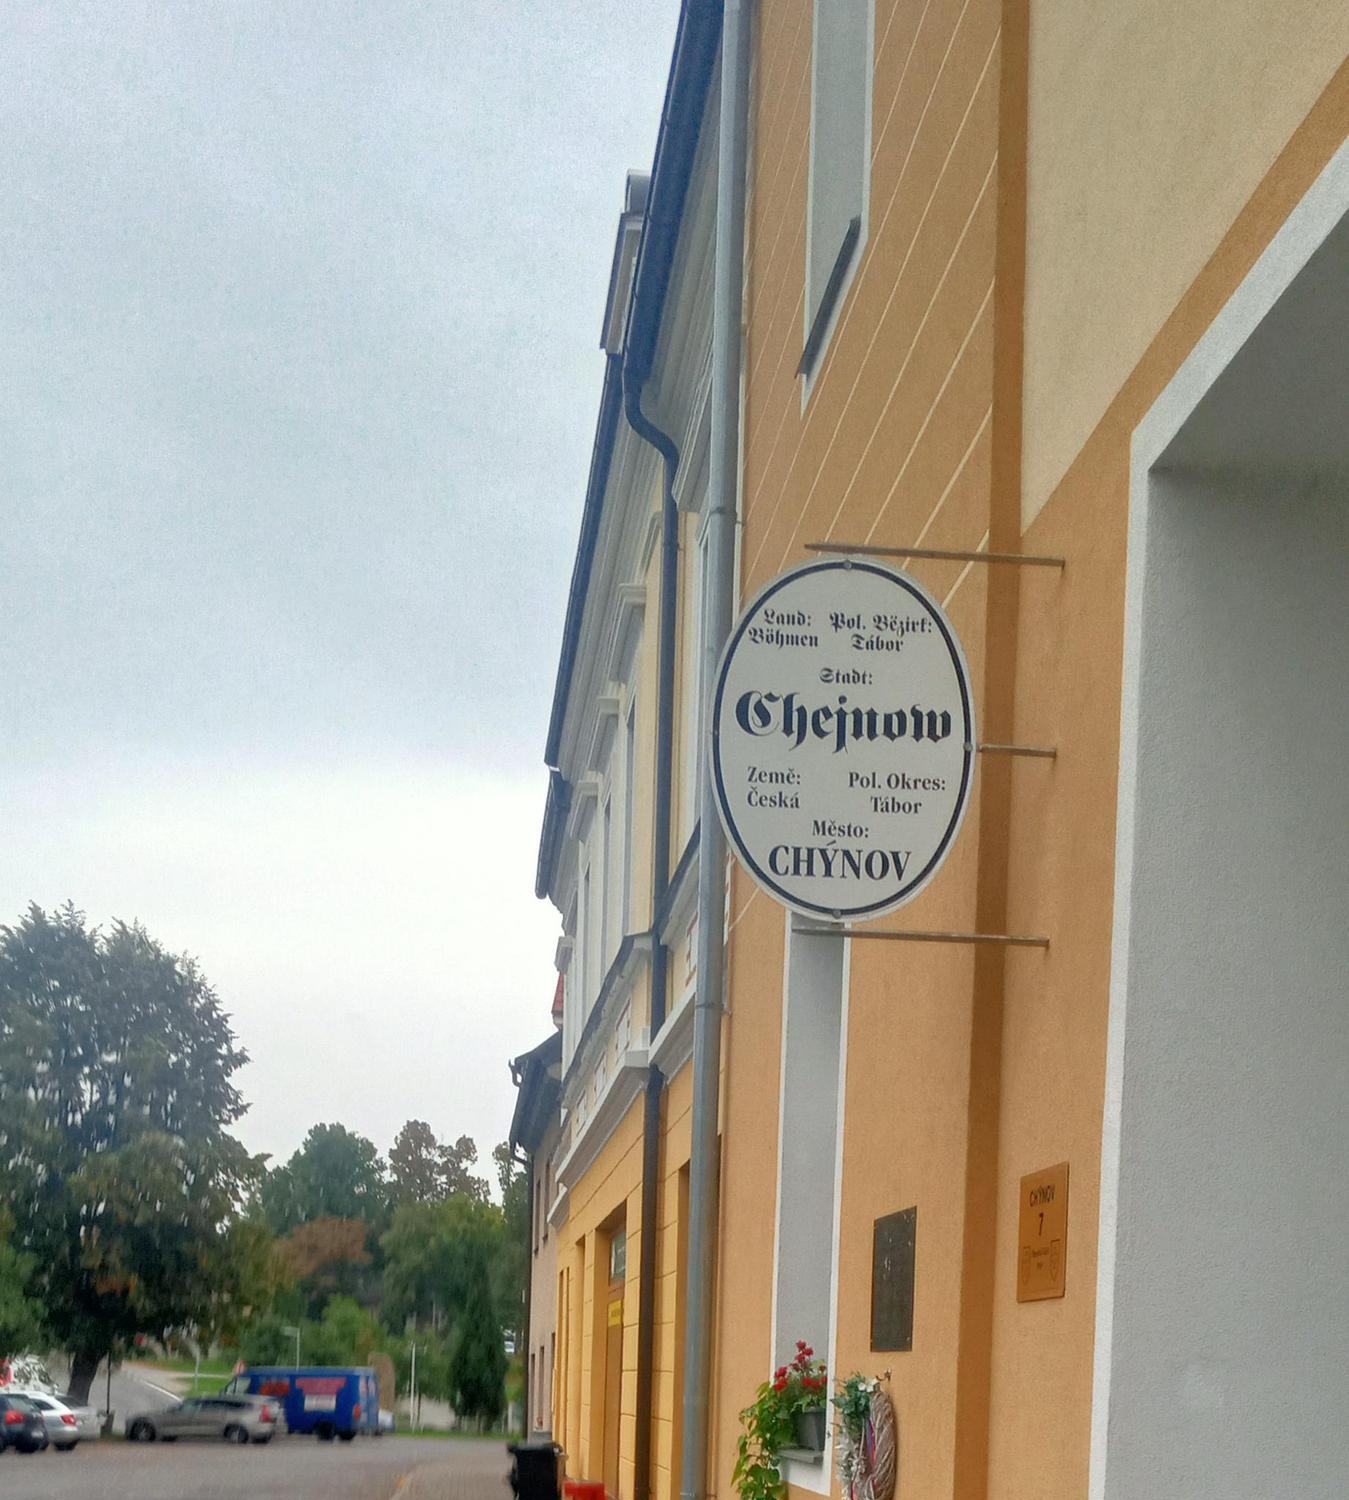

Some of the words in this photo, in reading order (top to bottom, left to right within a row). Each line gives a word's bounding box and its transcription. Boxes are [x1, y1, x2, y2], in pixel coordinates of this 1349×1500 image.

[764, 609, 812, 627] Land:
[829, 612, 866, 633] Pol.
[748, 627, 819, 649] Böhmen
[852, 633, 904, 652] Tábor
[819, 667, 873, 685] Stadt:
[735, 690, 952, 754] Chejnow
[747, 766, 801, 785] Země:
[848, 771, 882, 789] Pol.
[886, 773, 946, 791] Okres:
[747, 786, 800, 809] Česká
[870, 795, 923, 815] Tábor
[812, 819, 870, 838] Město:
[768, 840, 913, 881] CHÝNOV
